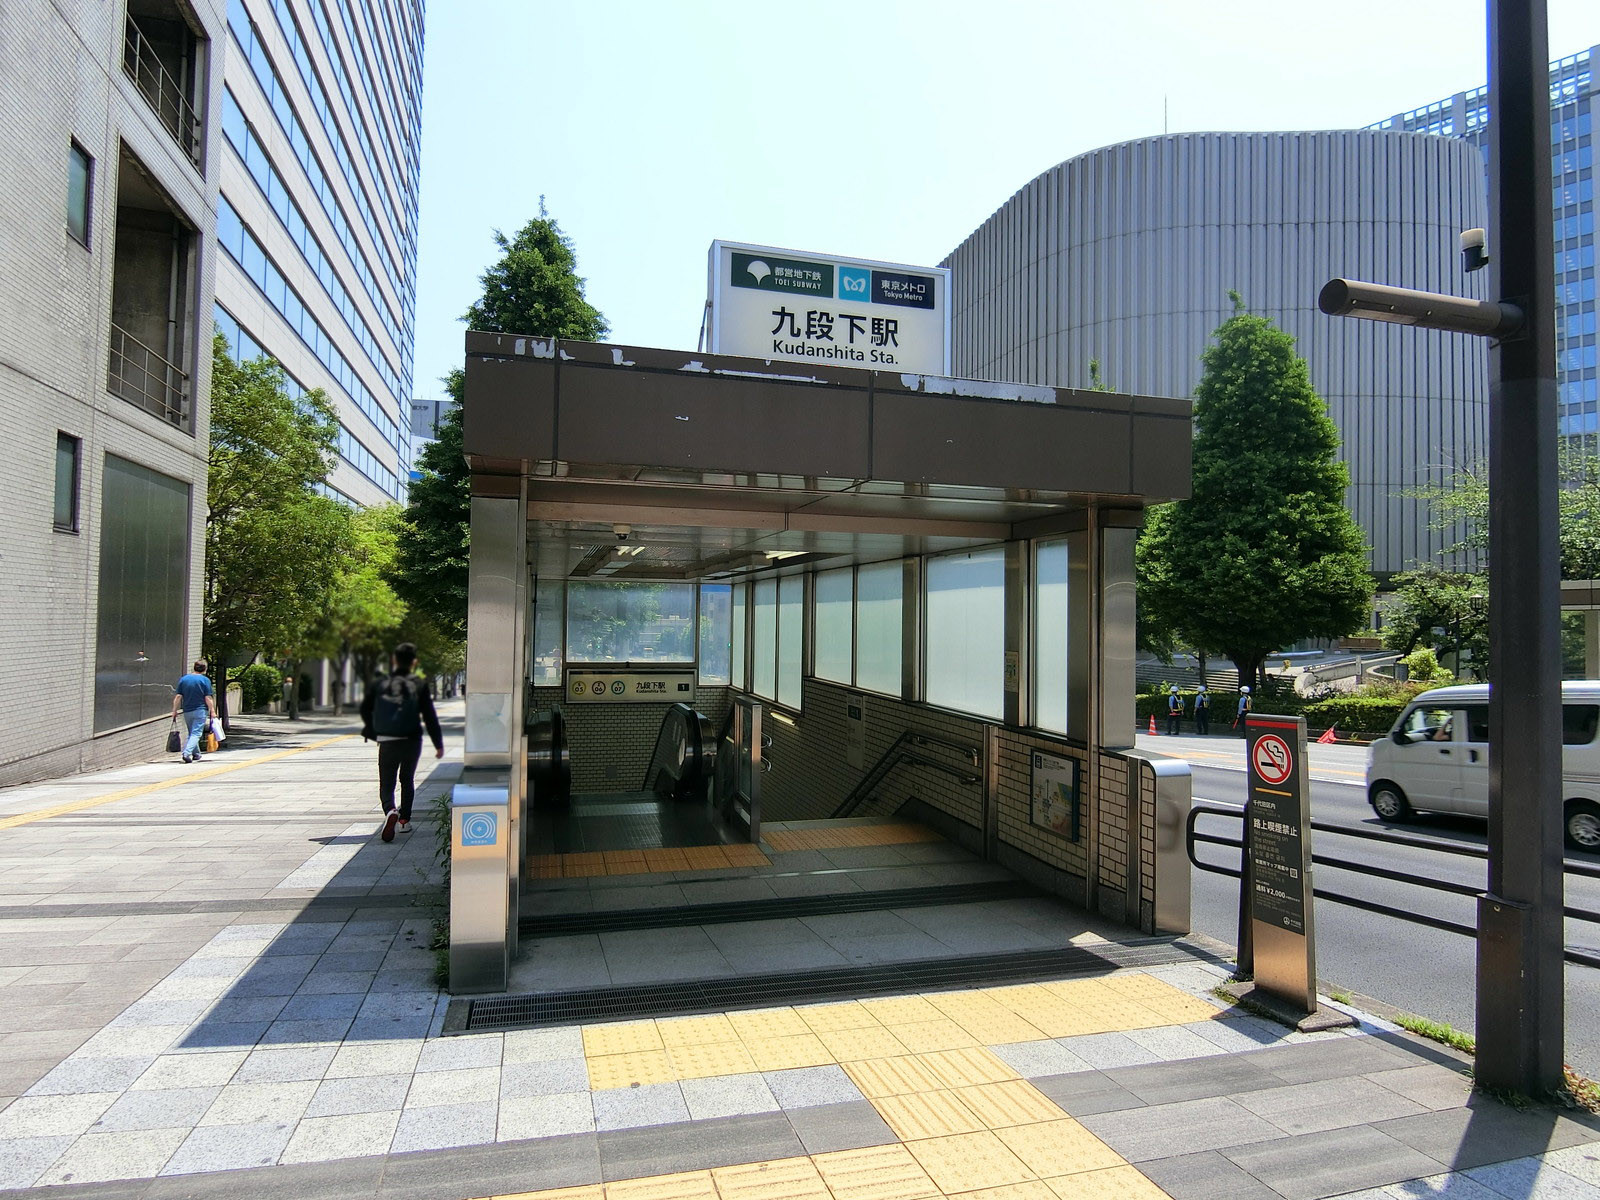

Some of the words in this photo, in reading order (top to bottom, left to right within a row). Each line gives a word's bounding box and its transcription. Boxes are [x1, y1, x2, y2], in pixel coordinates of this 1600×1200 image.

[774, 266, 822, 281] 都営地下鉄
[774, 278, 790, 287] TOEI
[792, 280, 822, 290] SUBWAY
[880, 279, 926, 294] 東京メトロ
[884, 291, 903, 300] Tokyo
[903, 292, 923, 301] Metro
[771, 306, 899, 348] 九段下駅
[773, 339, 865, 362] Kudanshita
[870, 349, 899, 365] Sta.
[636, 681, 666, 690] 九段下駅
[1253, 818, 1298, 837] 路上喫煙禁止
